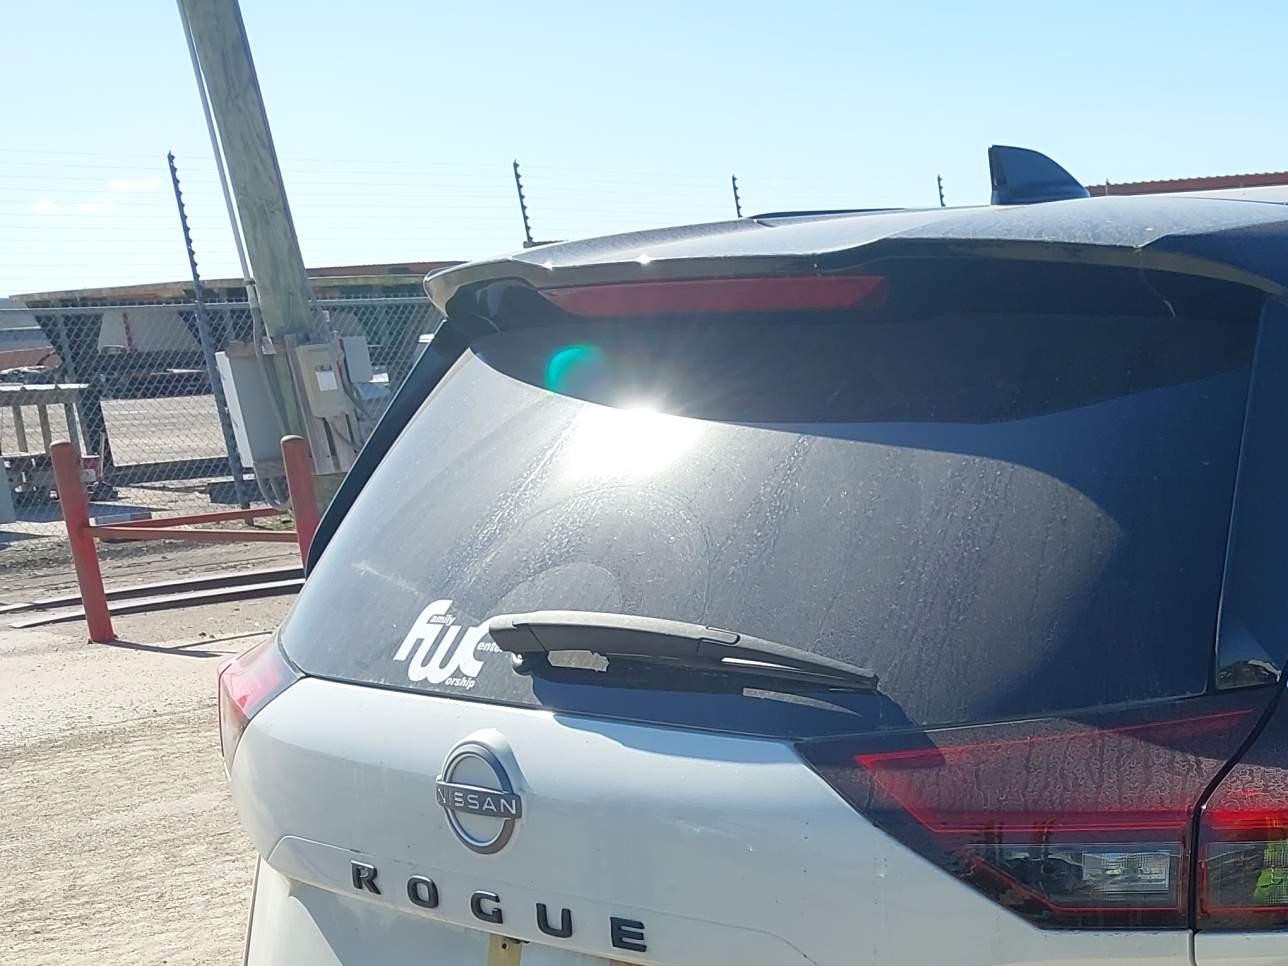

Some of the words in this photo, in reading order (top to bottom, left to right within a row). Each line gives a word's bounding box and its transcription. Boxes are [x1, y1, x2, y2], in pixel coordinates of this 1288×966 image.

[477, 641, 503, 653] ent
[437, 787, 516, 815] NISSAN
[350, 859, 647, 953] ROGUE
